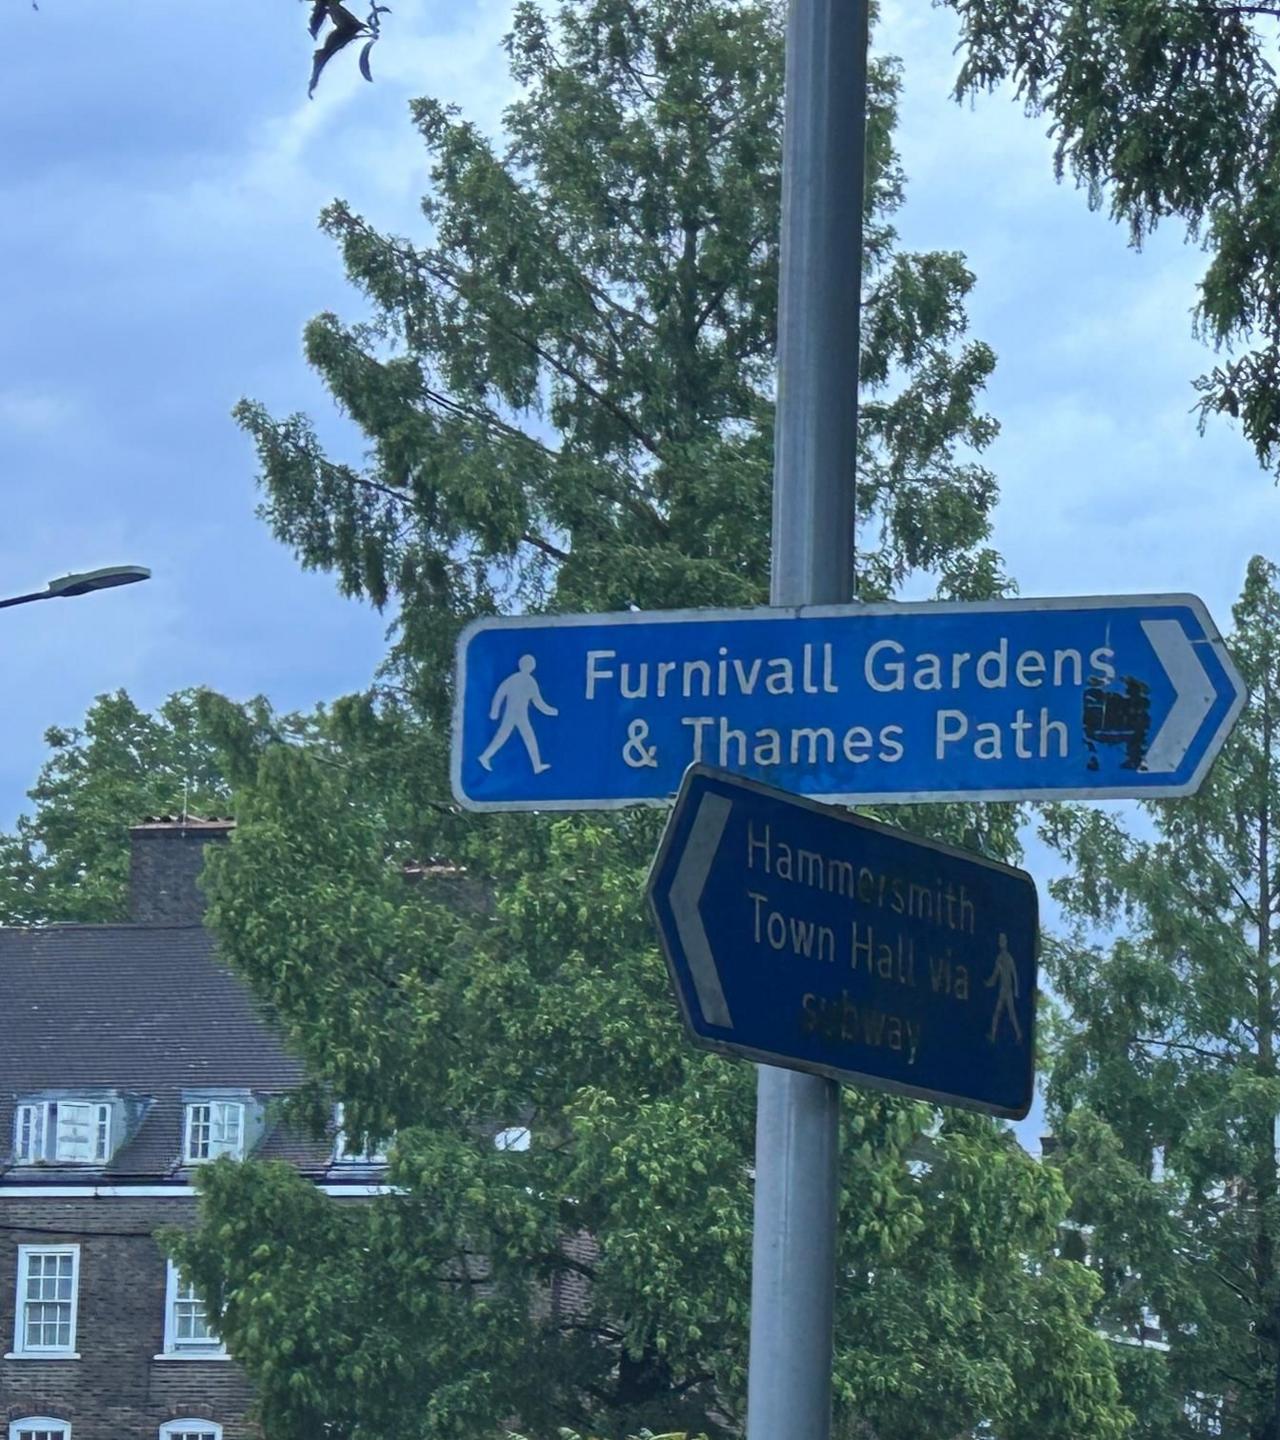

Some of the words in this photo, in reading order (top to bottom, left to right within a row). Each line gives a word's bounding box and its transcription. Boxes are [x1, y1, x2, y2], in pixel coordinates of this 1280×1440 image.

[585, 642, 839, 700] Furnivall
[863, 636, 1117, 693] Gardens
[621, 717, 658, 769] &
[681, 716, 905, 769] Thames
[935, 706, 1069, 760] Path
[747, 818, 975, 935] Hammersmith
[747, 888, 836, 963] Town
[851, 920, 915, 986] Hall
[929, 946, 970, 1001] via
[802, 989, 921, 1065] subway
